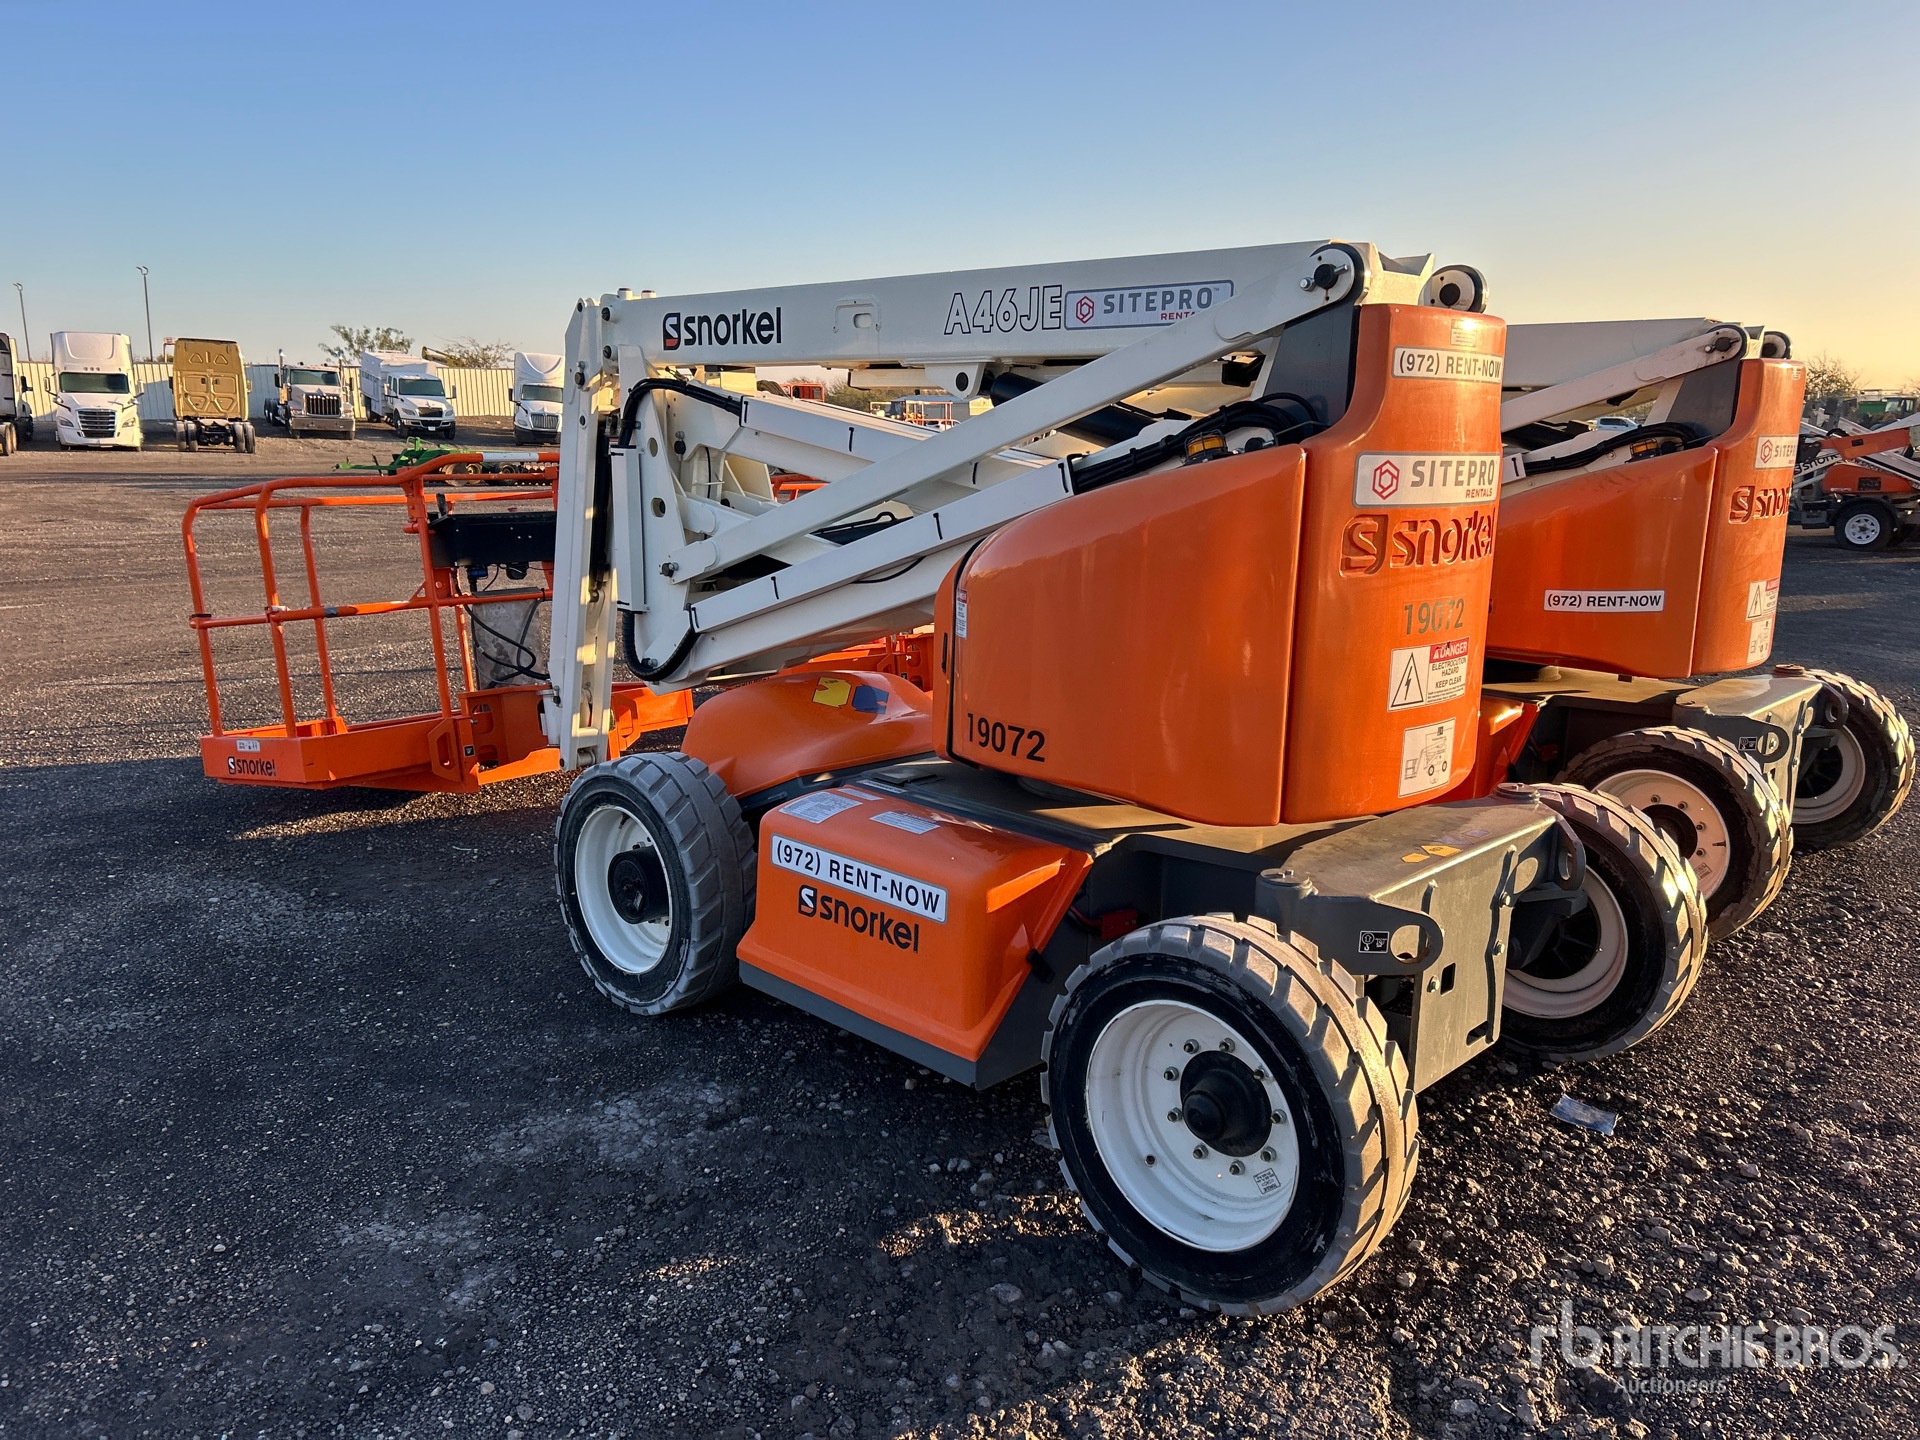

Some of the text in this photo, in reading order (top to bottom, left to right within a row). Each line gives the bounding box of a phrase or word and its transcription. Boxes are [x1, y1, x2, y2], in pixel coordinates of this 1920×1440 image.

[943, 284, 1062, 335] A46JE
[683, 306, 782, 346] snorkel
[1399, 350, 1502, 379] (972) RENT-NOW
[1410, 459, 1496, 488] SITEPRO
[1465, 487, 1493, 499] RENTALS
[1547, 593, 1662, 608] (972) RENT-NOW
[1404, 598, 1465, 635] 19072
[1431, 657, 1467, 671] ELECTROCUTION
[1440, 641, 1468, 659] DANGER
[1435, 676, 1462, 689] KEEP CLEAR
[1441, 666, 1460, 677] HAZARD
[967, 712, 1046, 763] 19072
[236, 758, 277, 777] snorkel
[776, 839, 940, 914] (972) RENT-NOW
[819, 895, 920, 954] snorkel
